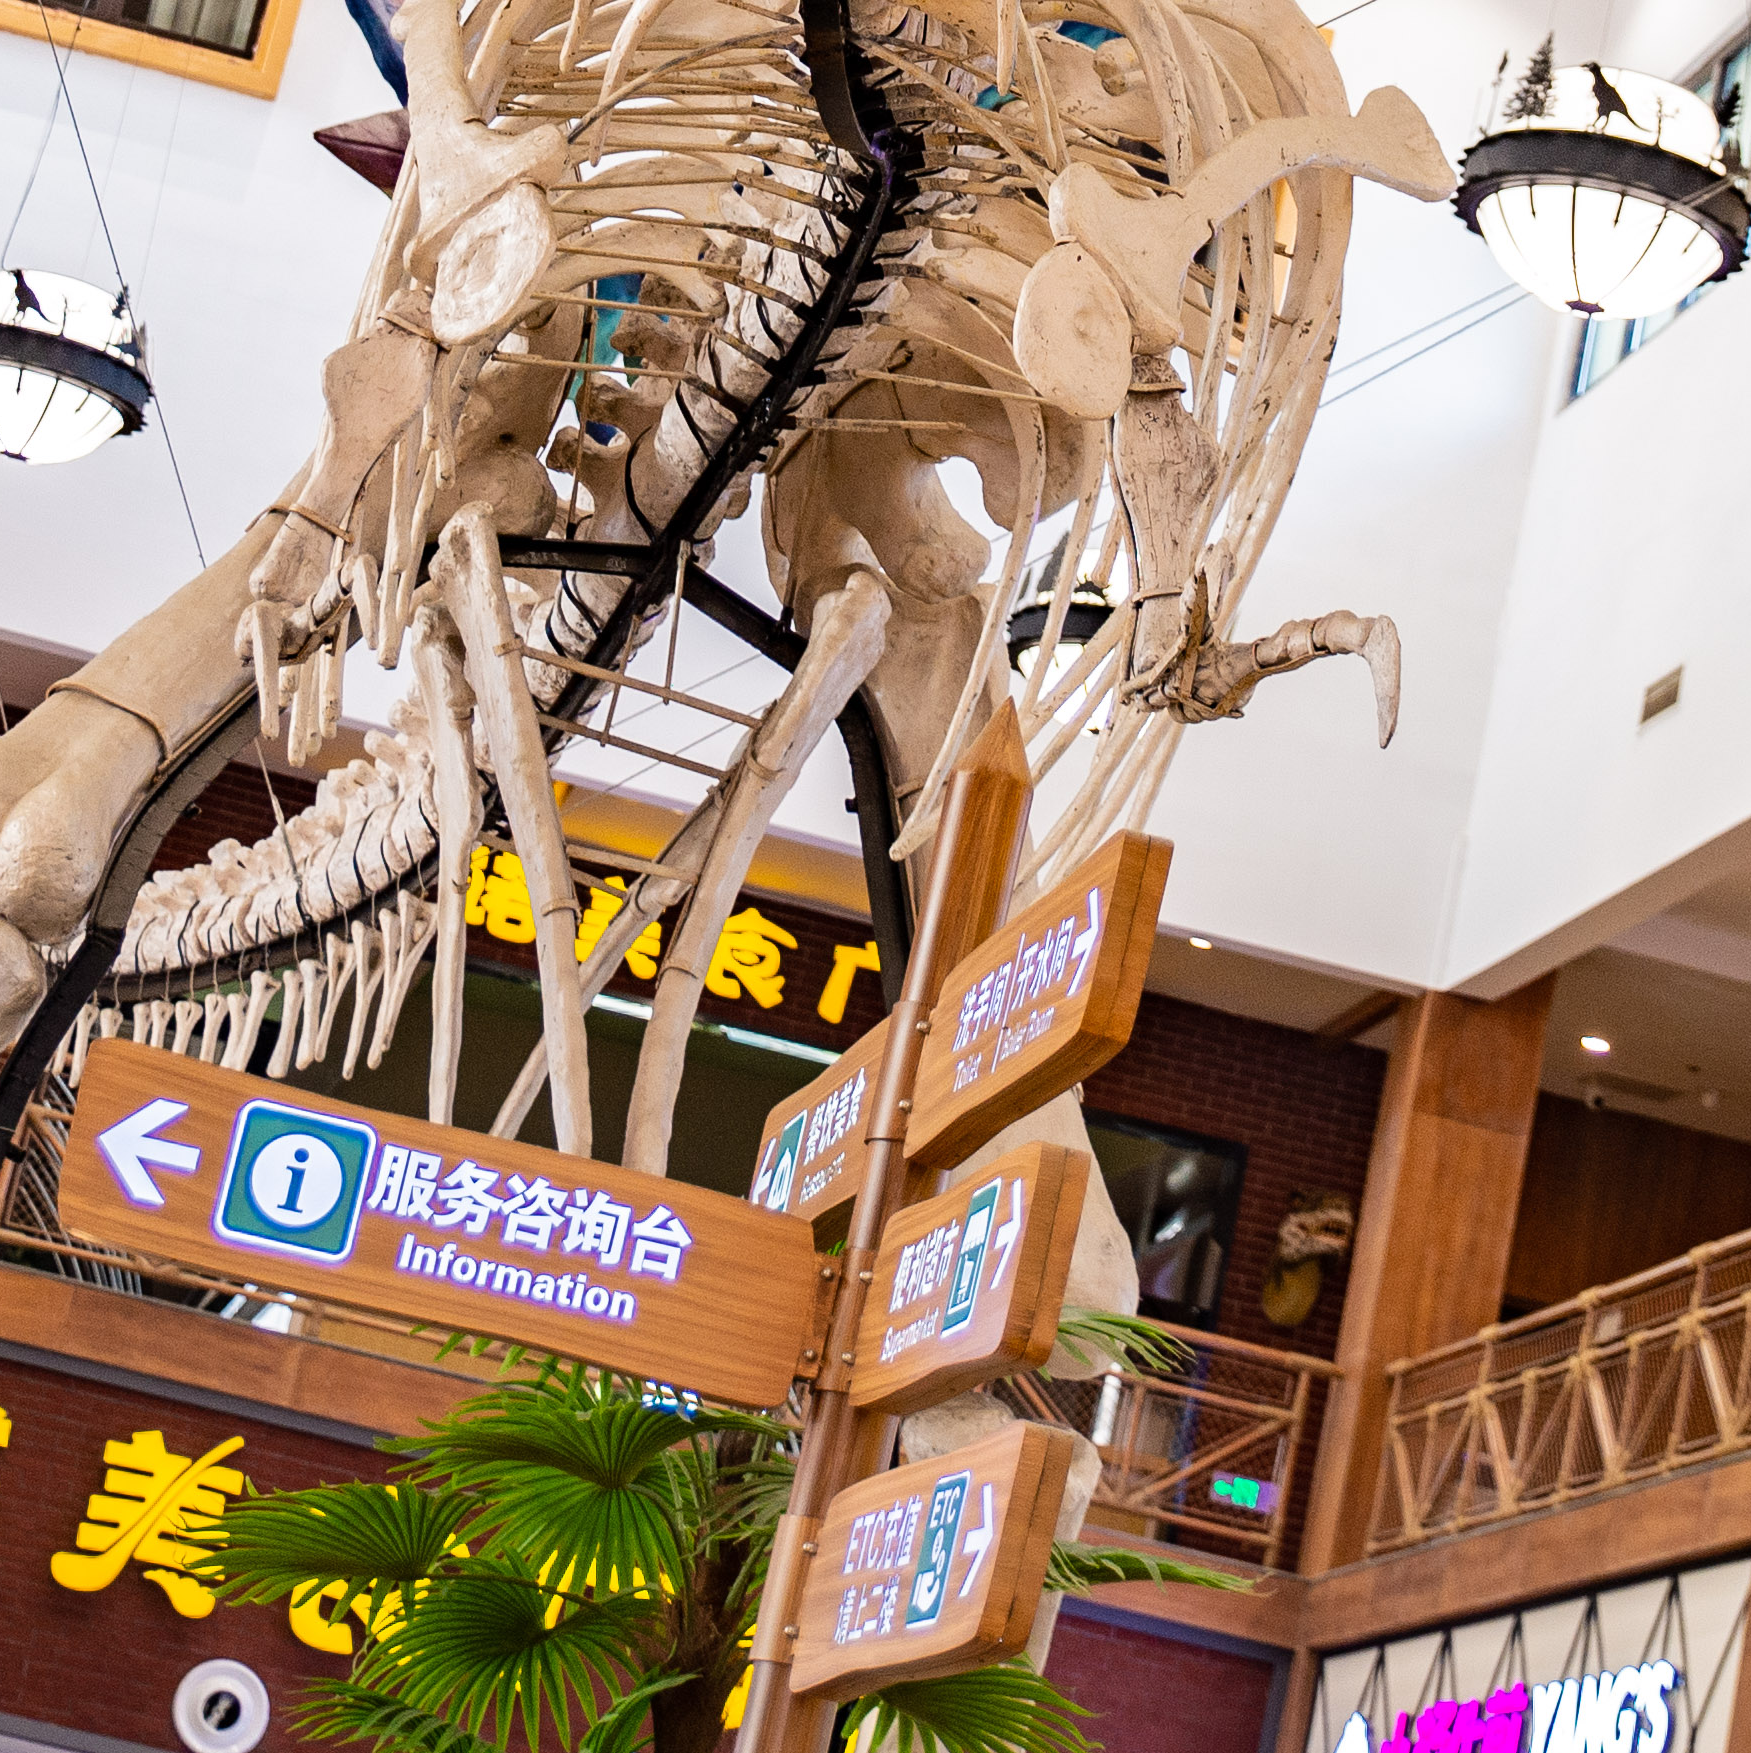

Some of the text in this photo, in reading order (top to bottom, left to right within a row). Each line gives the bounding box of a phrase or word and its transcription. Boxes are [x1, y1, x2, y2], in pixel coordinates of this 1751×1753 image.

[952, 915, 1076, 1053] 洗手间 开水间
[367, 1142, 692, 1282] 服务咨询台
[397, 1233, 636, 1321] Information
[889, 1218, 960, 1315] 便利超市
[843, 1494, 923, 1575] ETC充值
[929, 1486, 961, 1529] ETC
